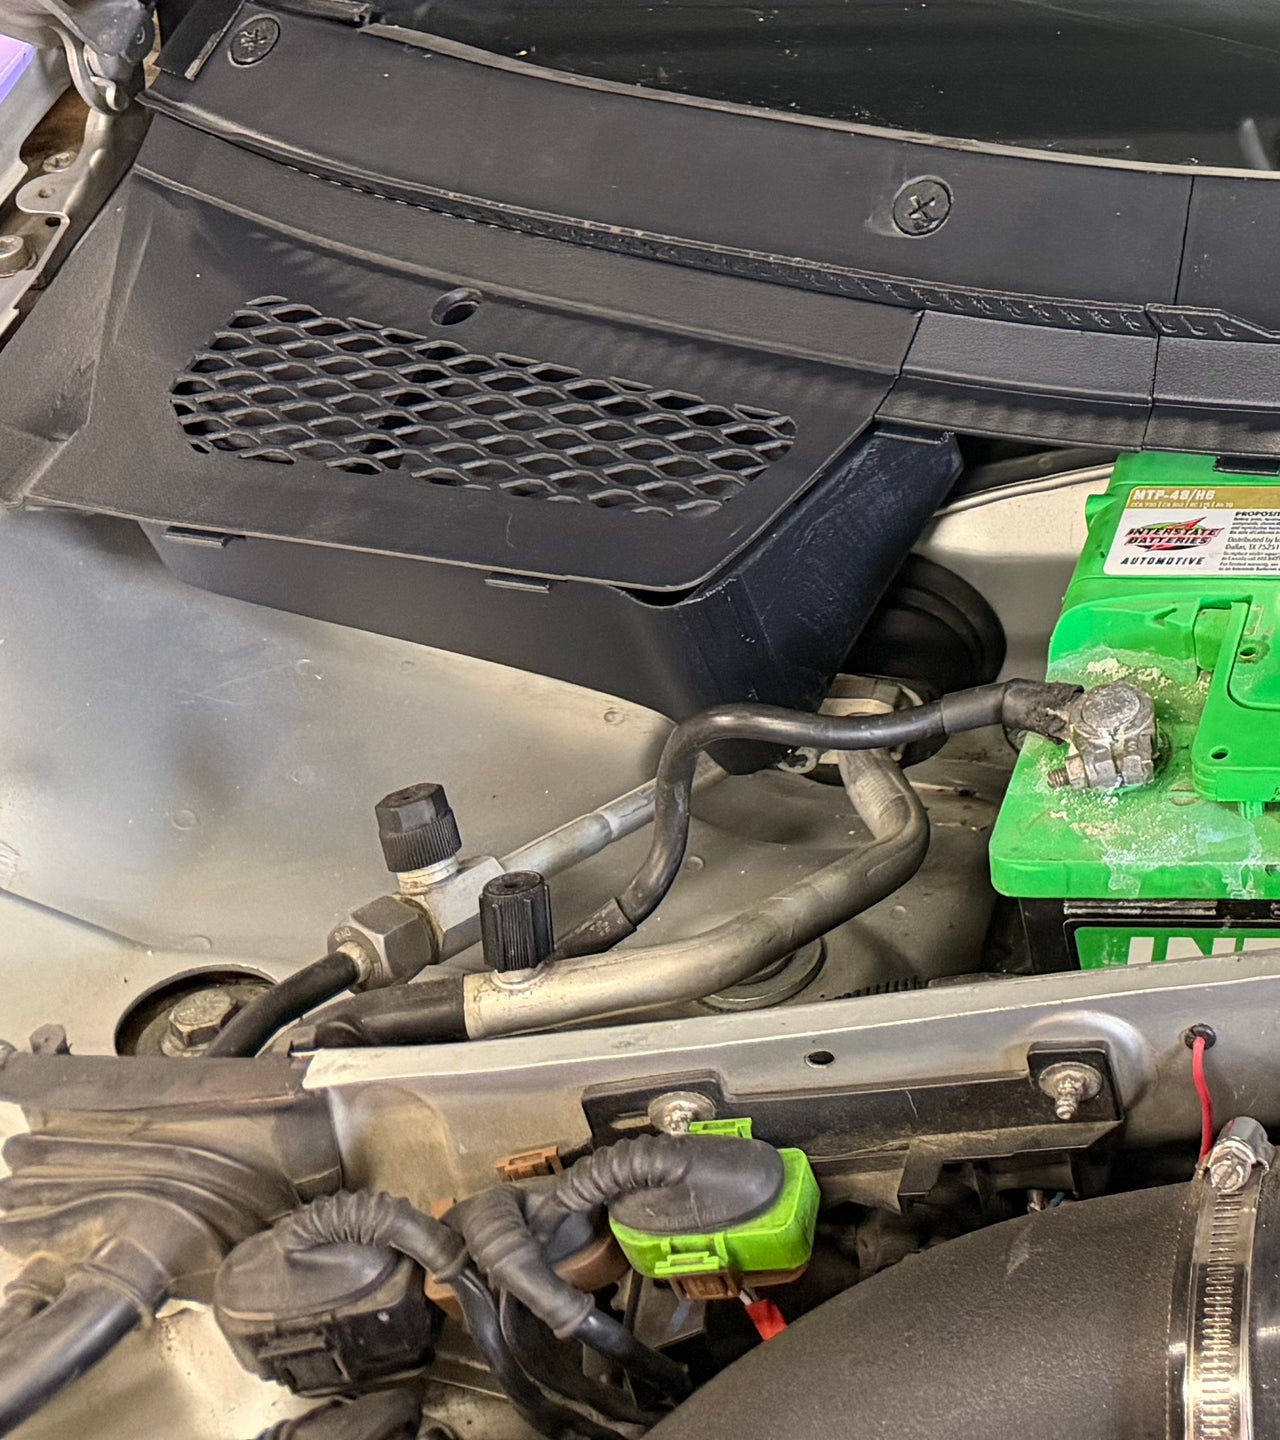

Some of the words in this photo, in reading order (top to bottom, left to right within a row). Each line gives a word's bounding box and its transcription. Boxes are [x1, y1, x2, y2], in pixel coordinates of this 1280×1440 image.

[1126, 527, 1219, 537] INTERSTATE
[1125, 536, 1211, 545] BATTERIES
[1120, 557, 1206, 565] AUTOMOTIVE
